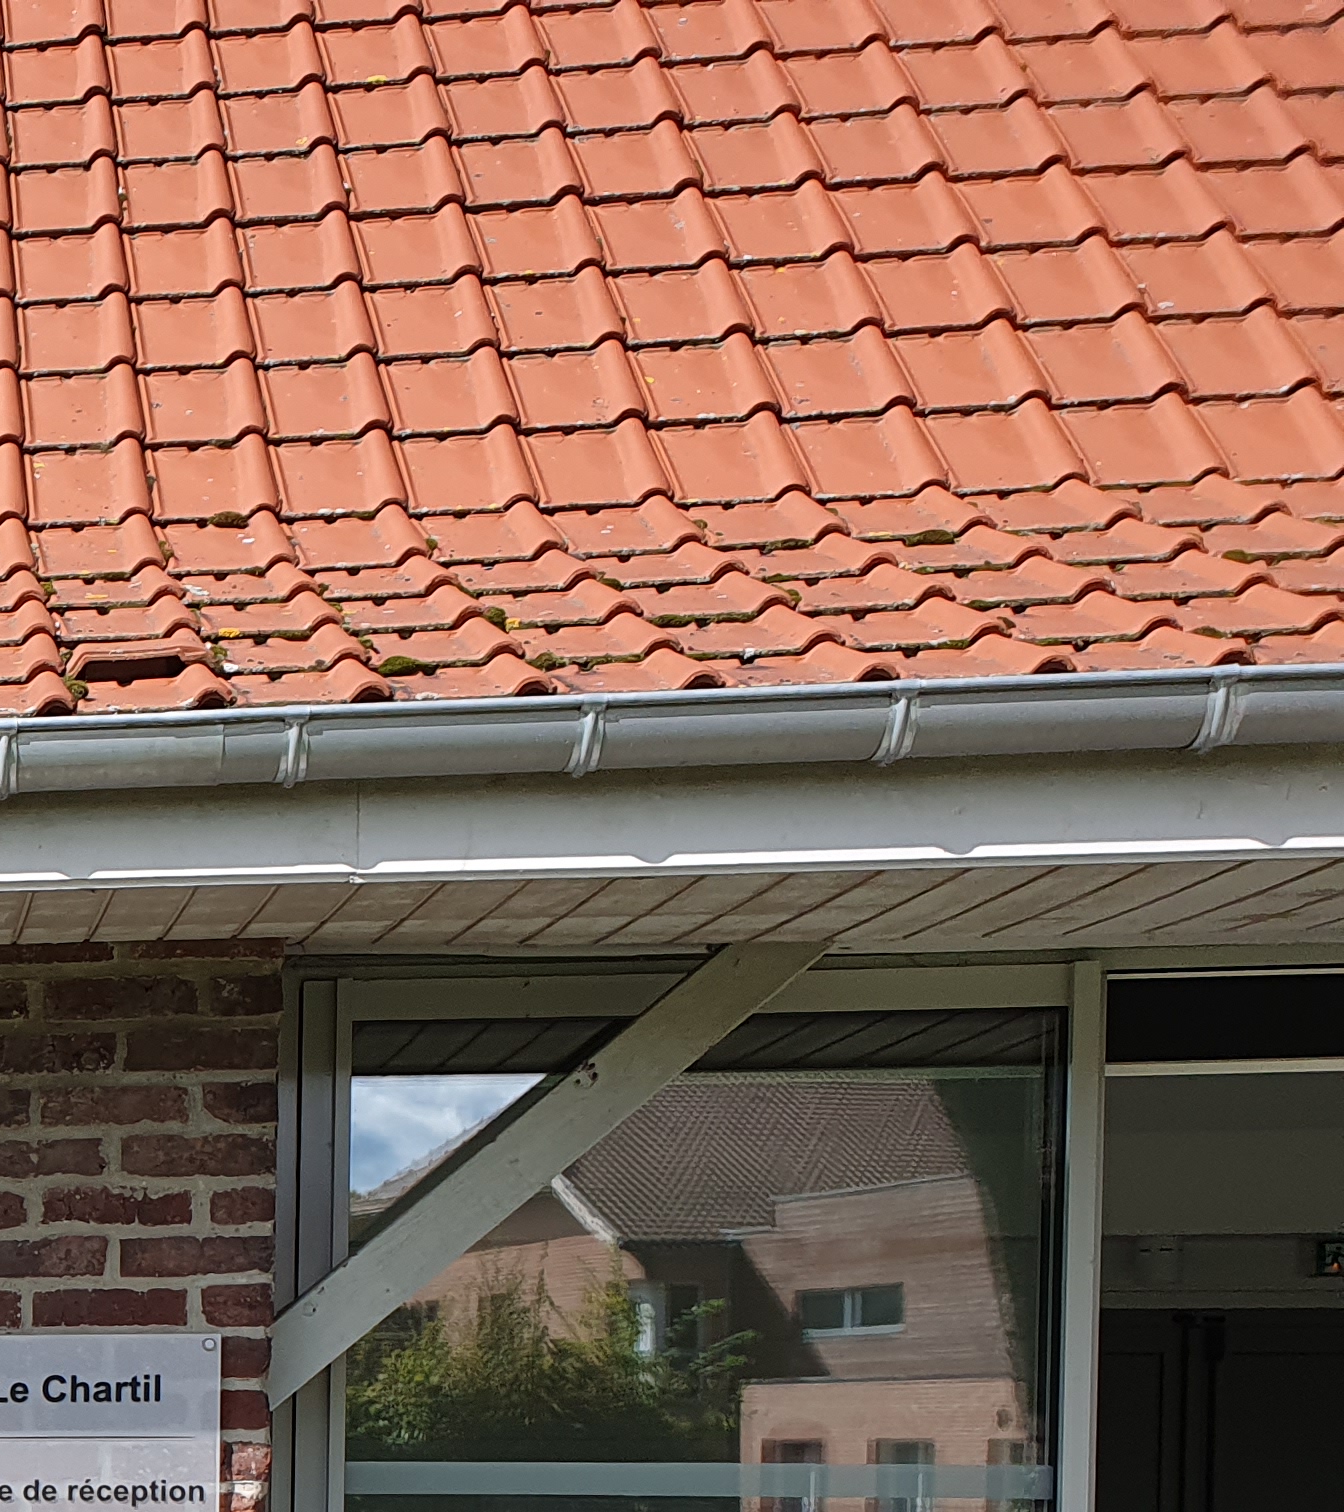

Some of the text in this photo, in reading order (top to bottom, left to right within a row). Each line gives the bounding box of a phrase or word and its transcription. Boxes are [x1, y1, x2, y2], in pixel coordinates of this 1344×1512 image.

[41, 1374, 162, 1403] Chartil
[23, 1479, 58, 1502] de
[68, 1478, 206, 1508] réception
